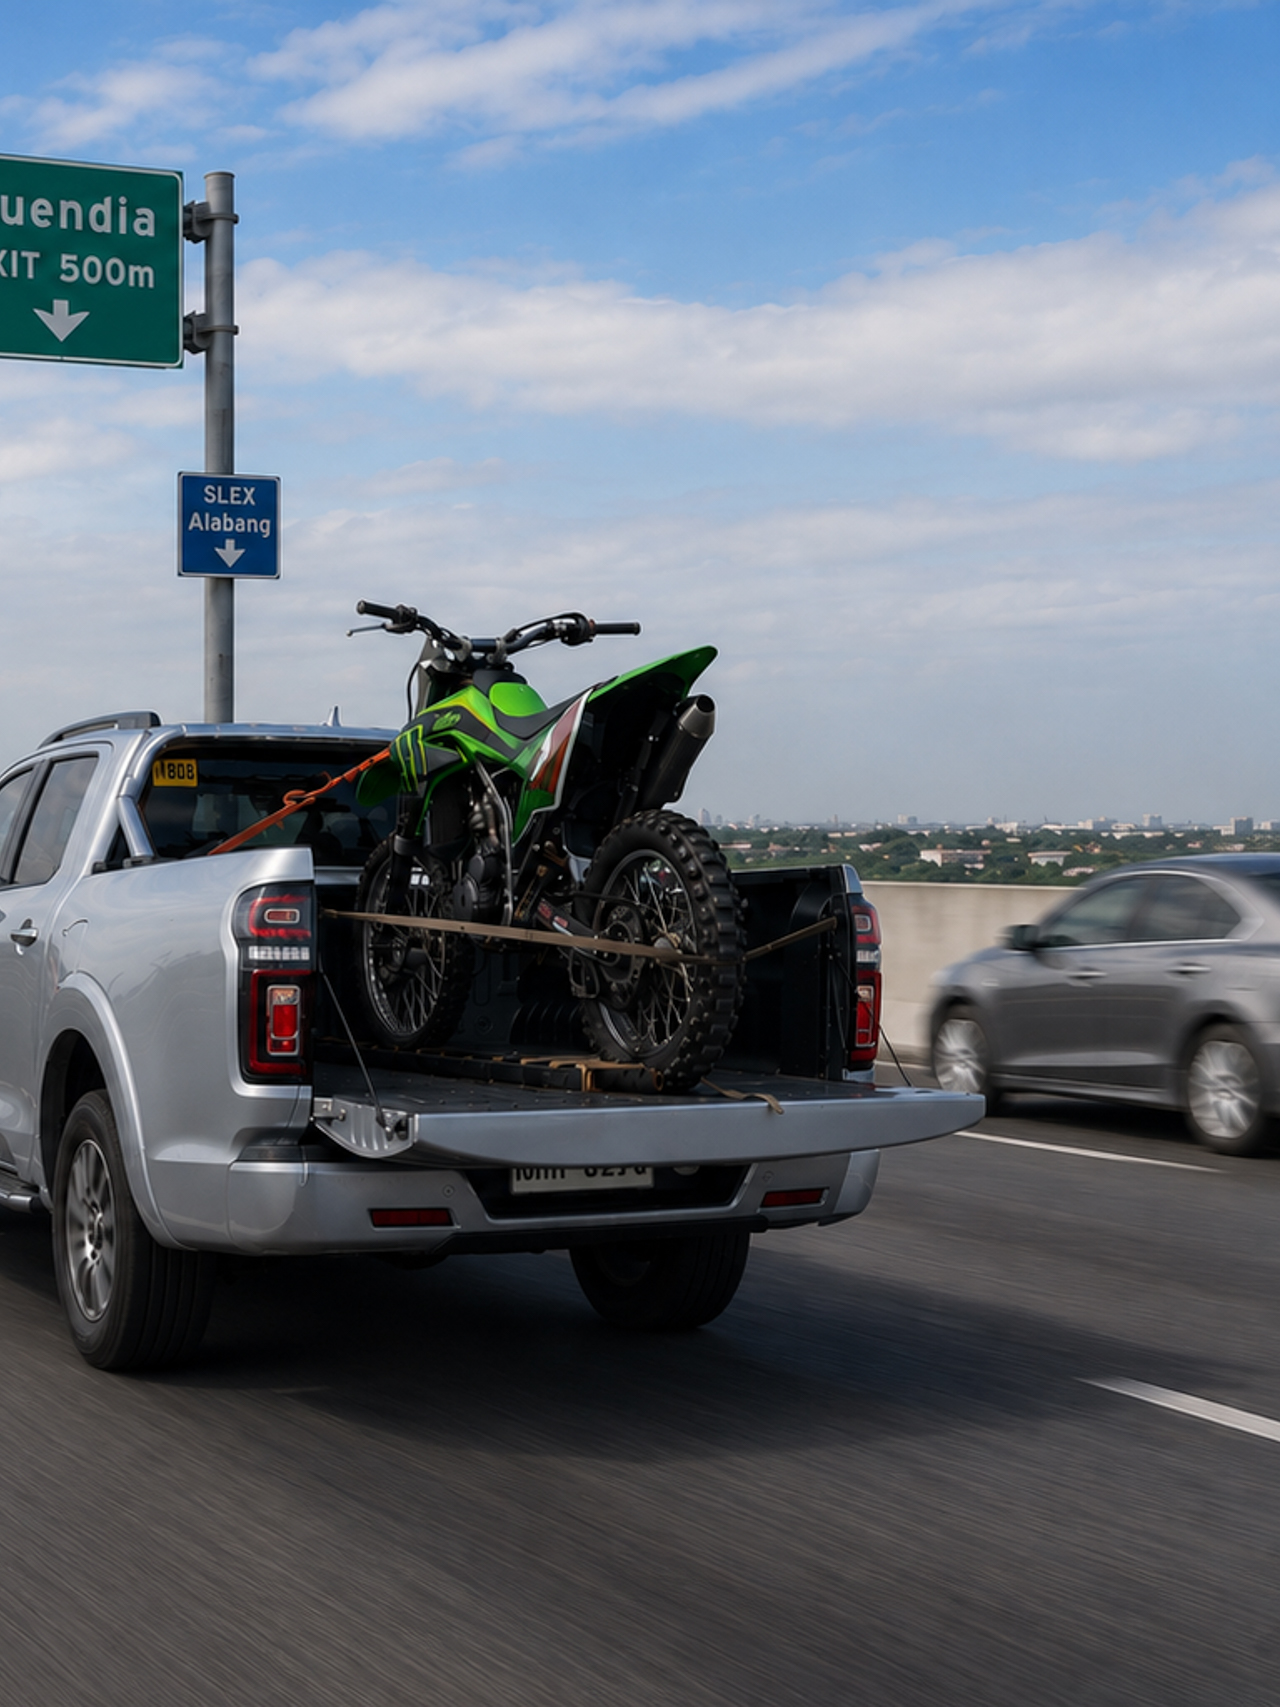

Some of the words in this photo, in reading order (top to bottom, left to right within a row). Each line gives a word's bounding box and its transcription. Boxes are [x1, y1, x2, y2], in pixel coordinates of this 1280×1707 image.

[59, 253, 155, 289] 500m
[203, 485, 256, 506] SLEX
[188, 511, 271, 538] Alabang
